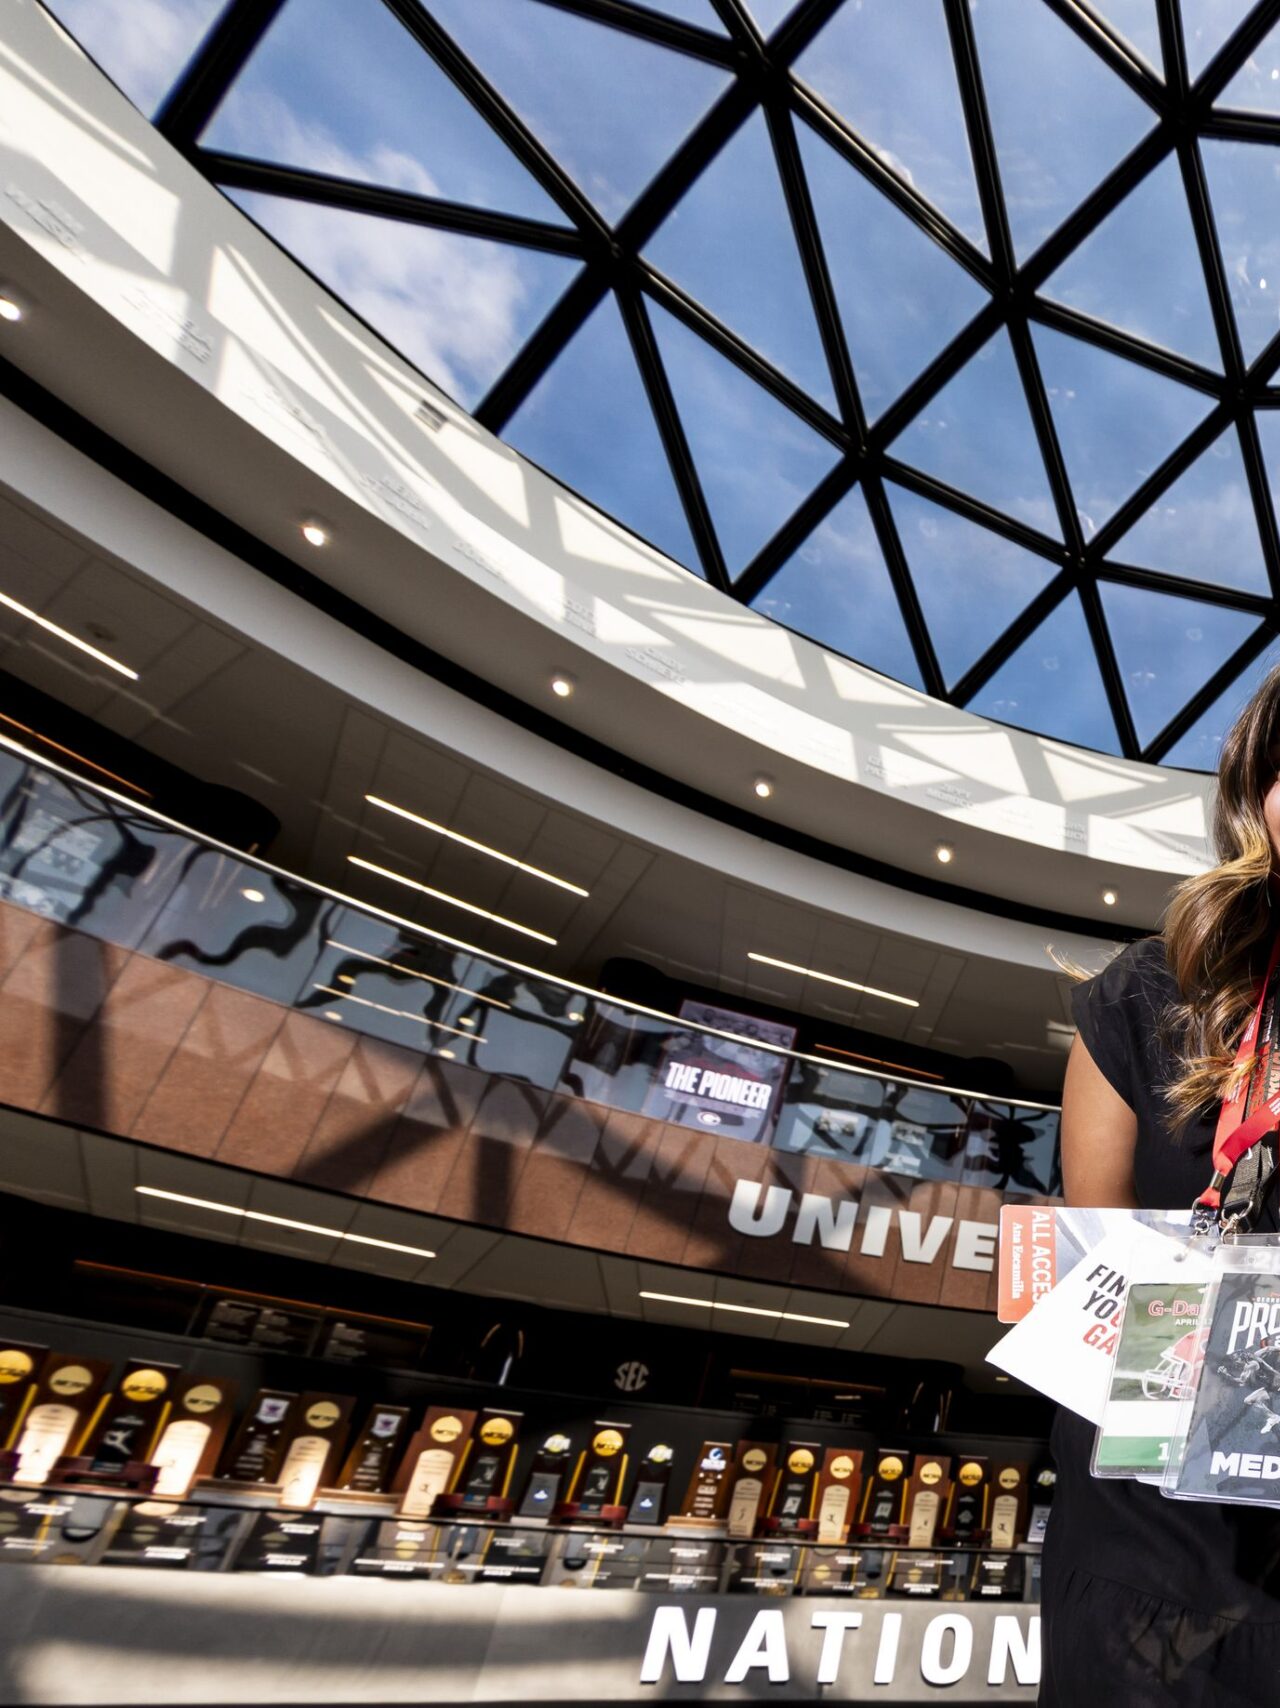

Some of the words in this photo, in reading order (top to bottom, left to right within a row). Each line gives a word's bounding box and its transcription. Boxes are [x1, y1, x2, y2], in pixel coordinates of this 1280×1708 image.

[664, 1061, 702, 1094] THE
[697, 1069, 773, 1111] PIONEER
[727, 1178, 999, 1273] UNIVE
[1012, 1221, 1022, 1246] Ana
[1031, 1209, 1051, 1242] ALL
[1031, 1243, 1053, 1304] ACCES
[613, 1360, 650, 1392] SEC
[639, 1605, 1042, 1686] NATION
